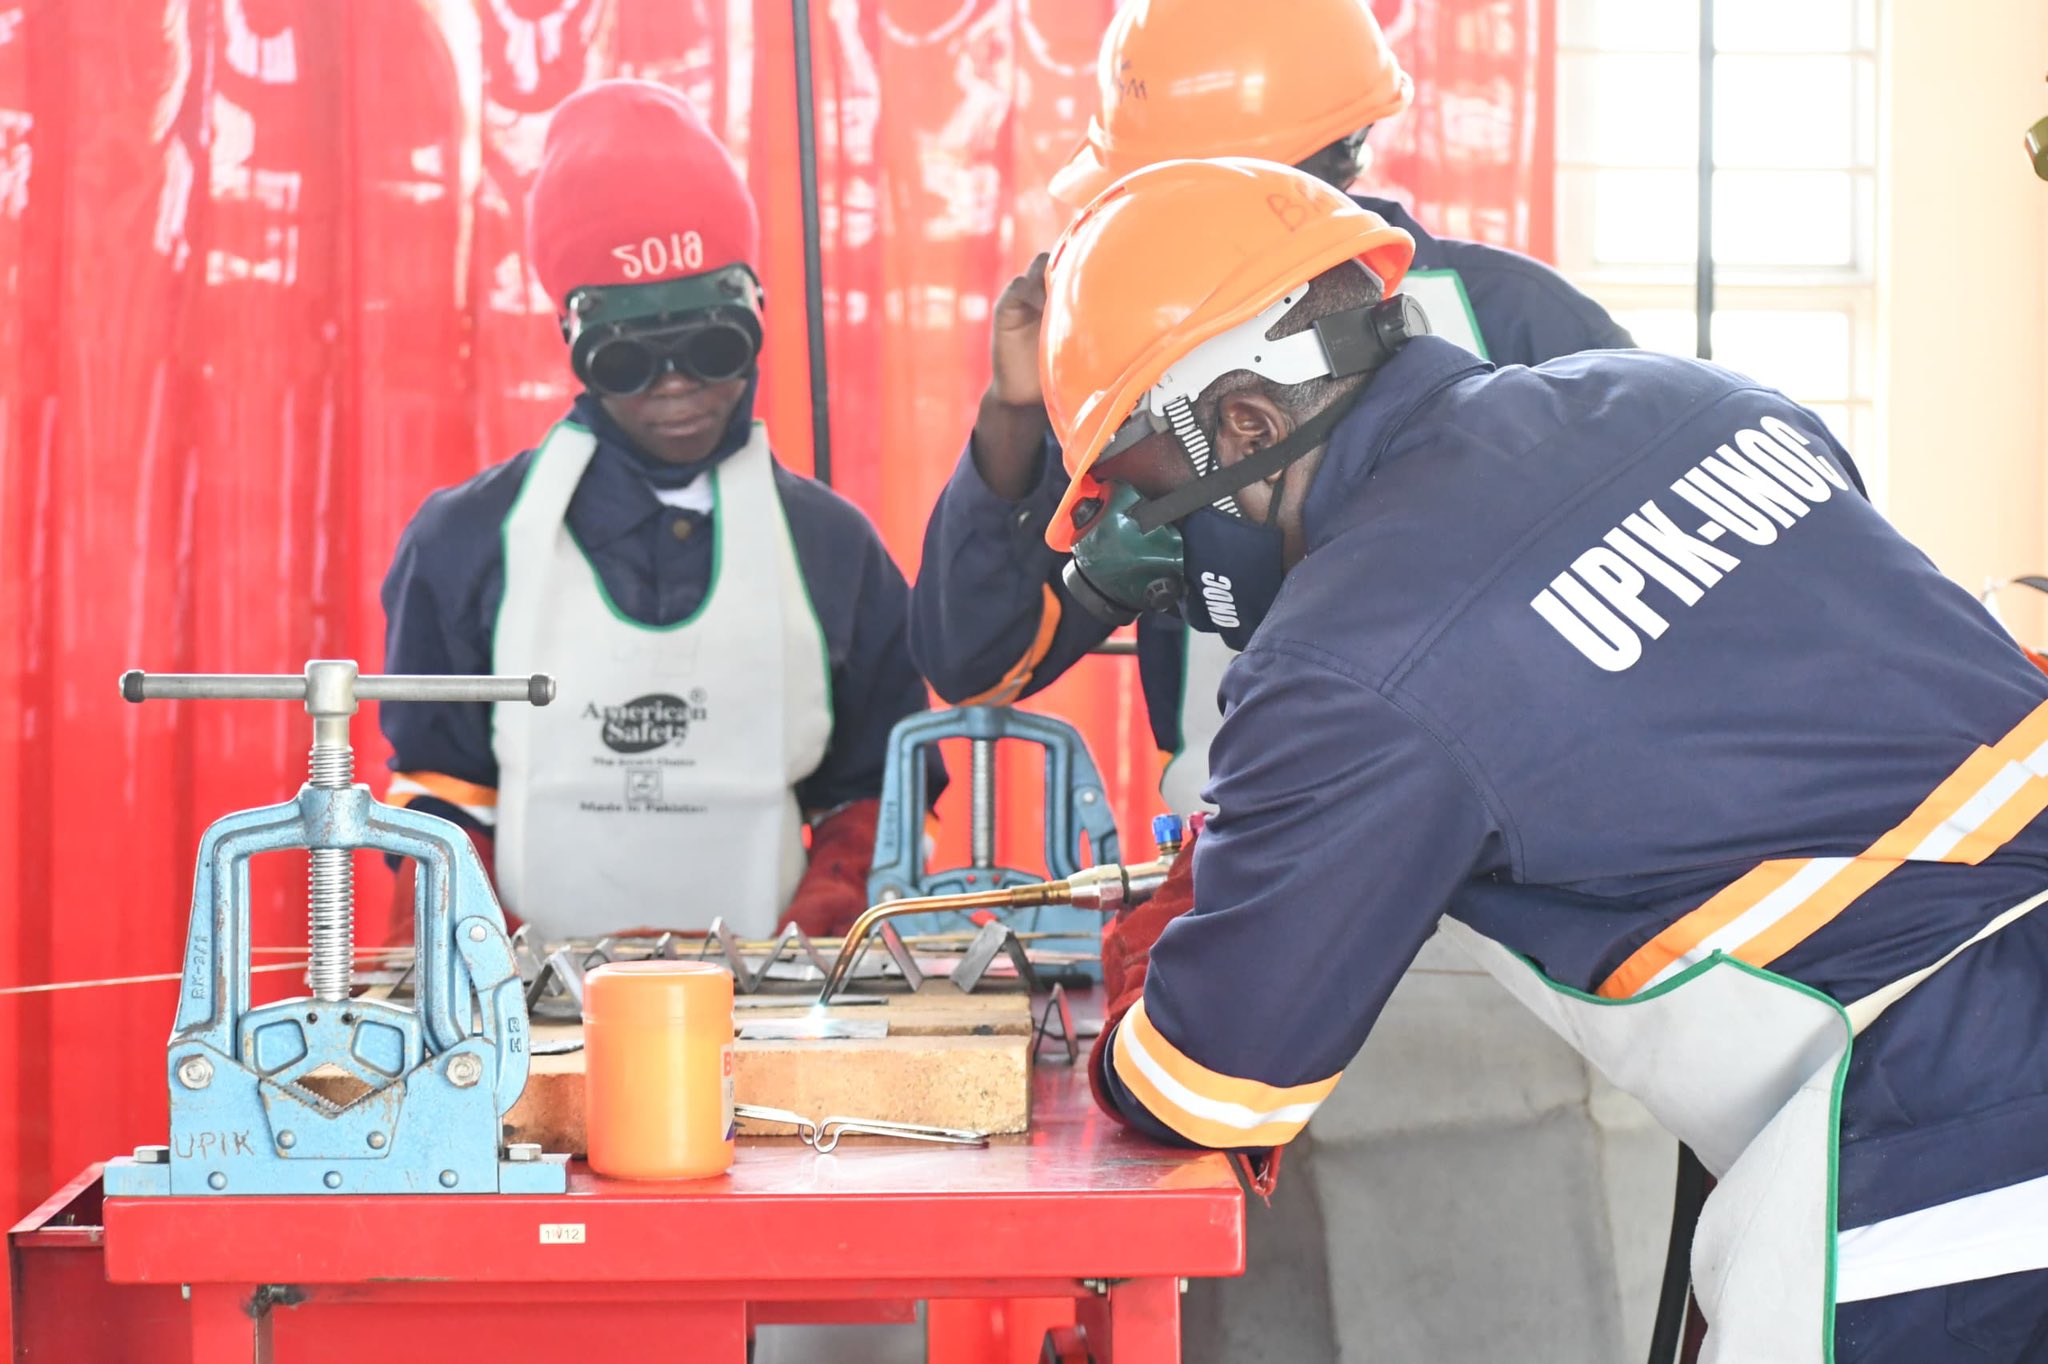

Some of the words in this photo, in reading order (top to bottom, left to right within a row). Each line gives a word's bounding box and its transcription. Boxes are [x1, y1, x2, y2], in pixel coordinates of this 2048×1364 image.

[1529, 415, 1850, 672] UPIK-UNOC
[1200, 571, 1241, 628] UNOC
[582, 700, 707, 722] American
[605, 721, 688, 747] Safety
[174, 1129, 255, 1160] UPIK
